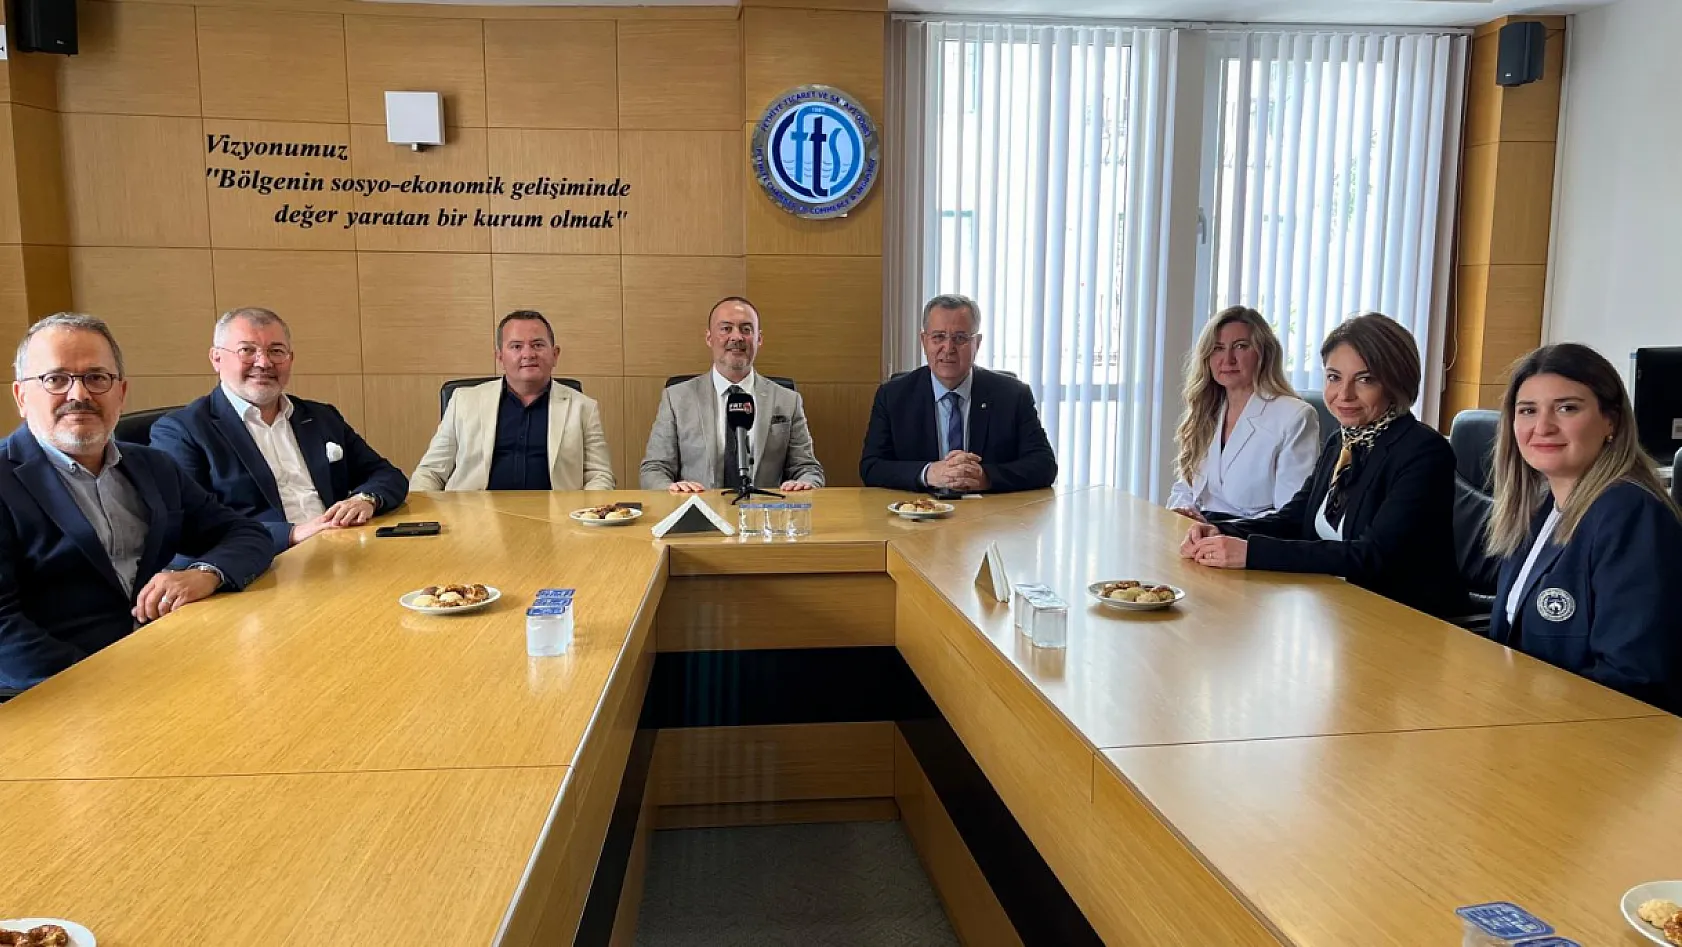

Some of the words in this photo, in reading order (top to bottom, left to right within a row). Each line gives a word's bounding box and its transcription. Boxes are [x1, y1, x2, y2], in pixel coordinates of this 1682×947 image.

[207, 134, 348, 161] Vizyonumuz
[330, 175, 505, 197] sosyo-ekonomik
[511, 177, 631, 201] gelişiminde
[274, 204, 338, 229] değer
[343, 210, 430, 230] yaratan
[437, 208, 468, 227] bir
[474, 209, 543, 228] kurum
